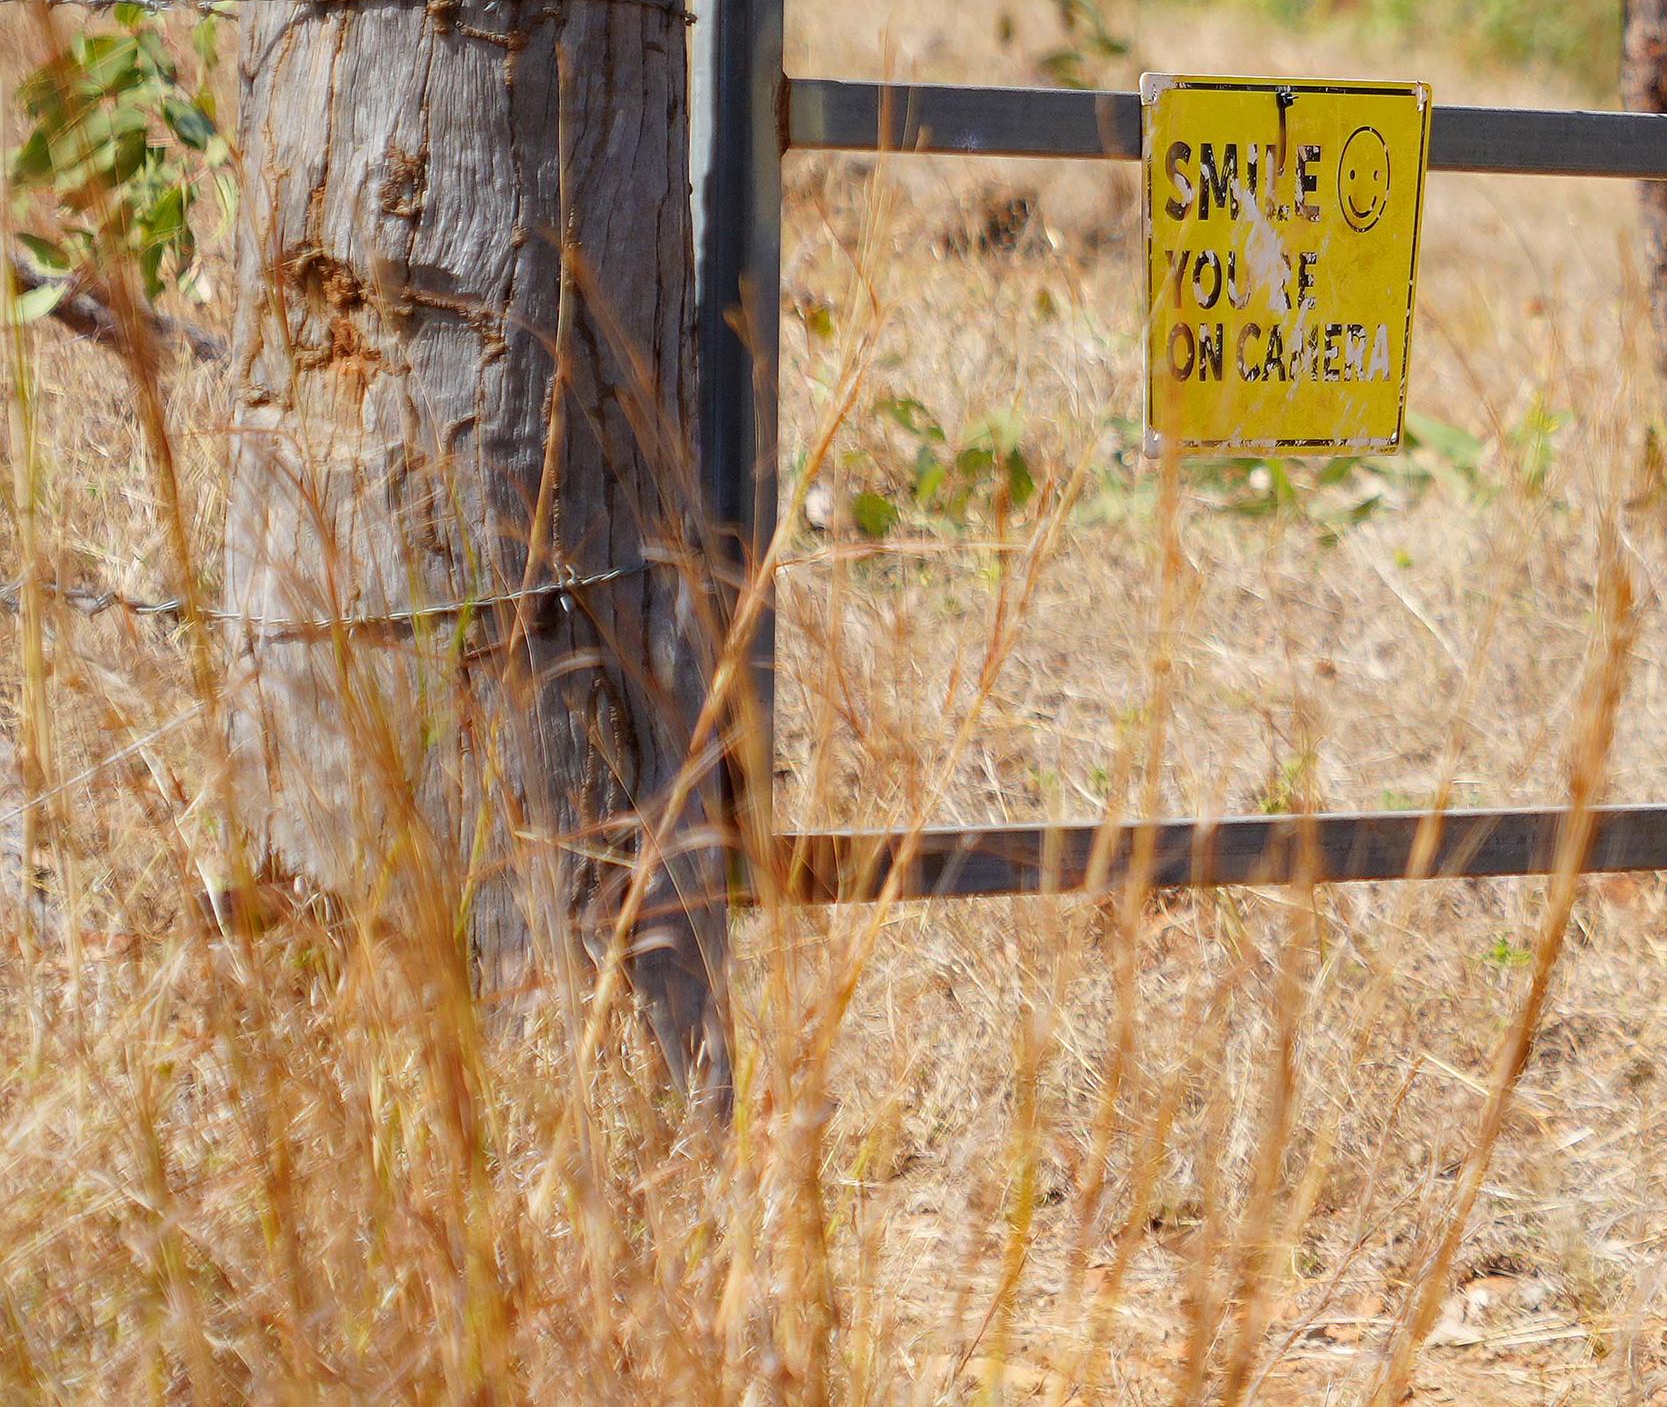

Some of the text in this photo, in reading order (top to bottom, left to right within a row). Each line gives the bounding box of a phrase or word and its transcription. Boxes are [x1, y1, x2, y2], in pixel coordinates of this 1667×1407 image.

[1164, 141, 1321, 222] SMILE
[1166, 322, 1391, 383] ON CAMERA
